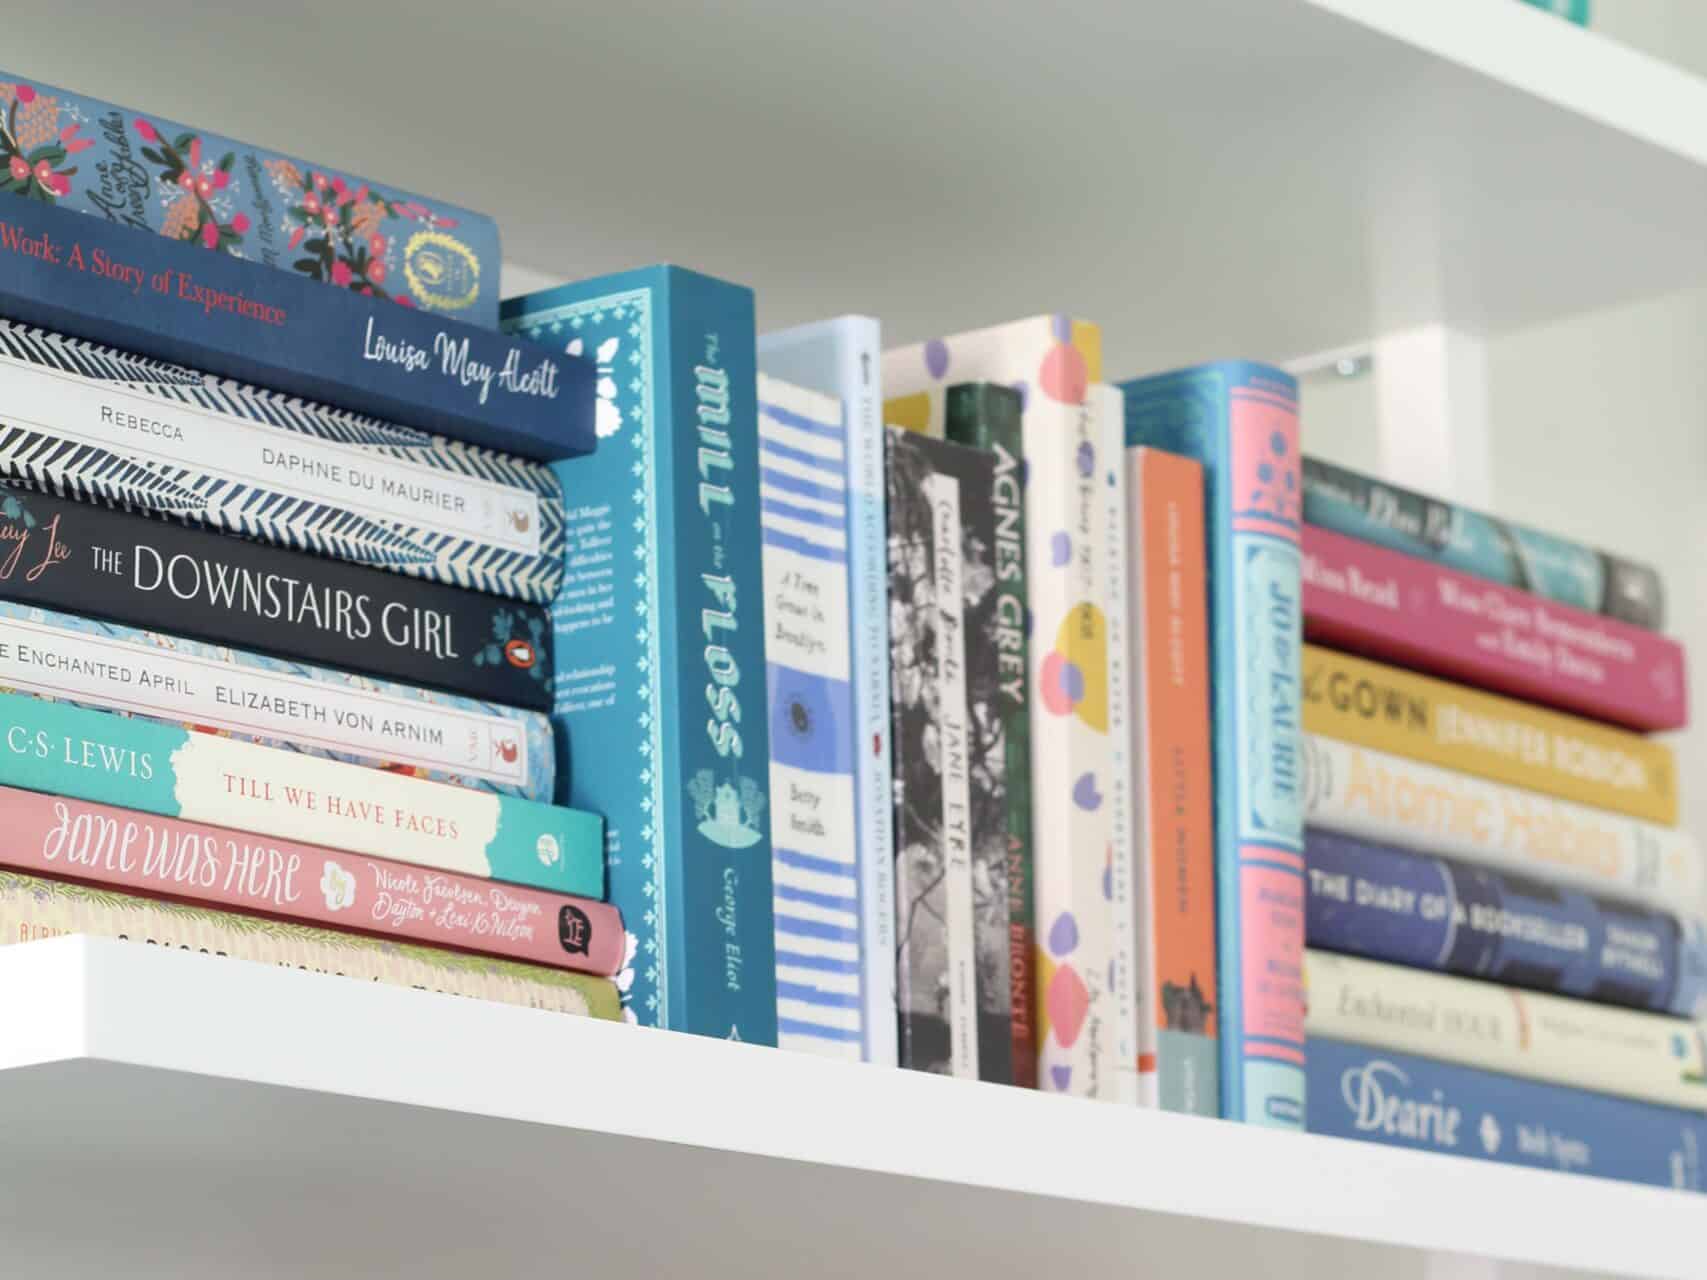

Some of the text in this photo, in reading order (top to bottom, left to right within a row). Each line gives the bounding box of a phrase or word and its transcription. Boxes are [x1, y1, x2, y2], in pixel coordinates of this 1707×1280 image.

[67, 243, 85, 271] A
[91, 248, 145, 294] Story
[152, 269, 173, 294] of
[178, 272, 287, 326] Experience
[363, 316, 560, 405] Louisa May Alcott
[262, 447, 343, 484] DAPHNE
[349, 470, 376, 493] DU
[382, 478, 467, 514] MAURIER
[694, 365, 735, 517] MILL
[91, 545, 124, 577] THE
[133, 545, 372, 641] DOWNSTAIRS
[381, 601, 460, 660] GIRL
[991, 441, 1025, 704] AGNES GREY
[139, 669, 195, 698] APRIL
[215, 685, 328, 724] ELIZABETH
[334, 707, 375, 733] VON
[381, 719, 445, 747] ARNIM
[701, 572, 744, 758] FLOSS
[63, 736, 155, 781] LEWIS
[223, 773, 460, 841] TILL WE HAVE FACES
[714, 866, 744, 993] George Eliot
[1309, 868, 1350, 902] THE
[1419, 893, 1448, 921] OF
[1340, 1060, 1461, 1147] Dearie
